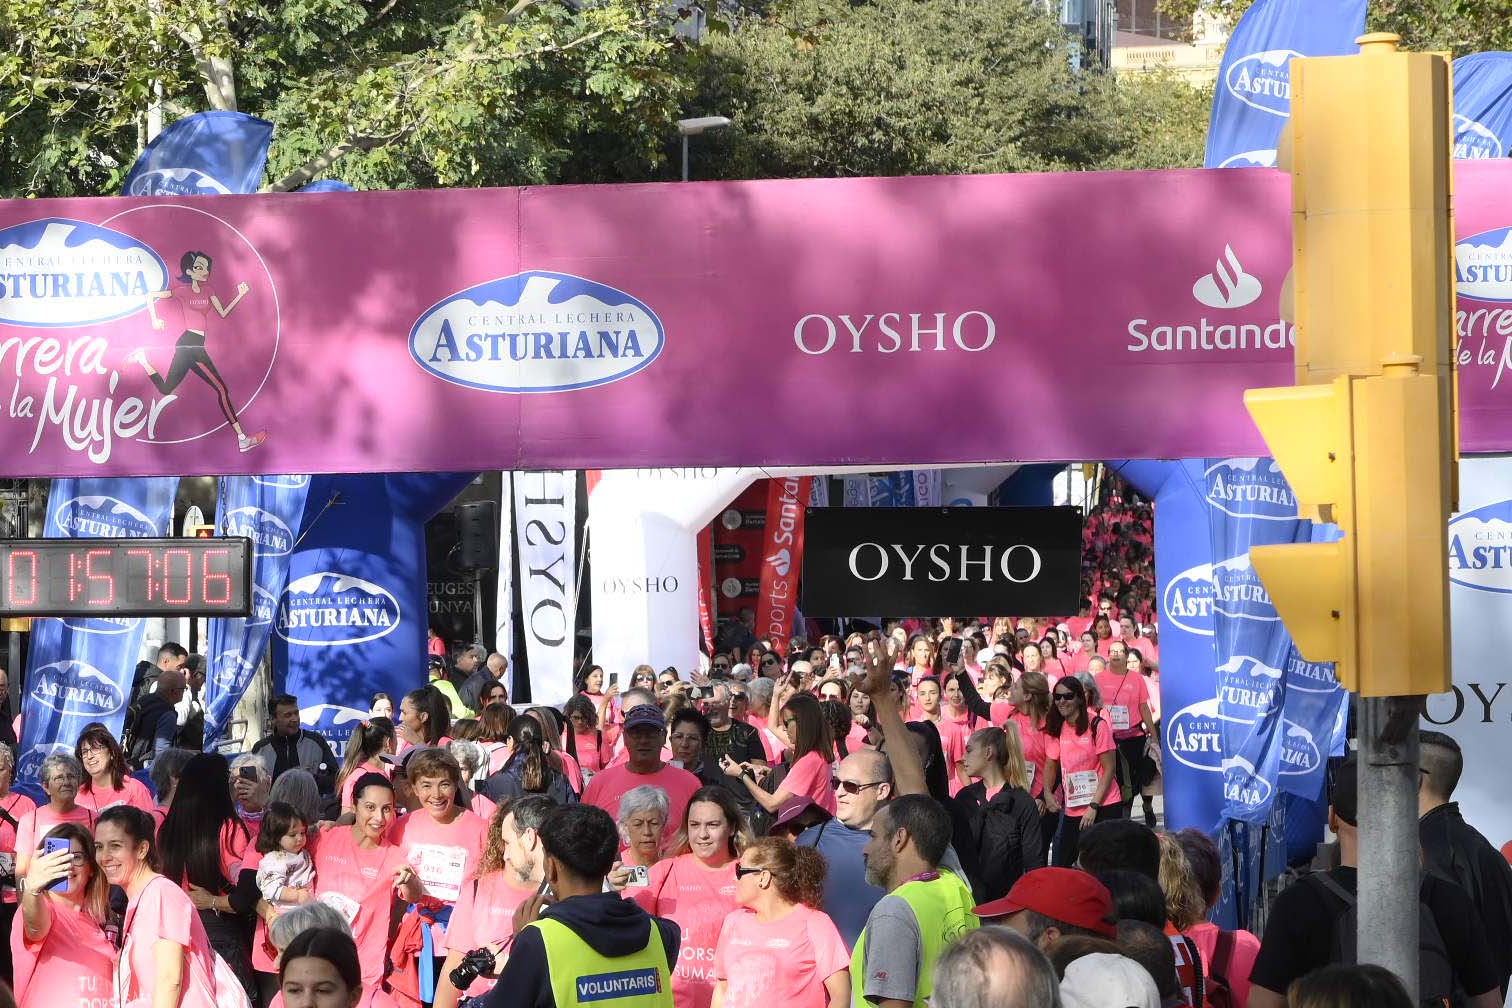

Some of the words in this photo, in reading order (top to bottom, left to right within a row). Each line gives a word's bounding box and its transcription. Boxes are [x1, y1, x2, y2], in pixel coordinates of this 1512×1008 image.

[468, 314, 545, 326] CENTRAL
[554, 312, 637, 324] LECHERA
[794, 310, 997, 355] OYSHO
[428, 318, 645, 363] ASTURIANA
[10, 378, 33, 418] la
[29, 370, 178, 464] Mujer
[9, 549, 231, 605] 01:57:06
[848, 543, 1042, 583] OYSHO
[279, 607, 391, 629] ASTURIANA
[291, 597, 333, 606] CENTRAL
[337, 597, 387, 606] LECHERA
[578, 975, 655, 996] VOLUNTARIS
